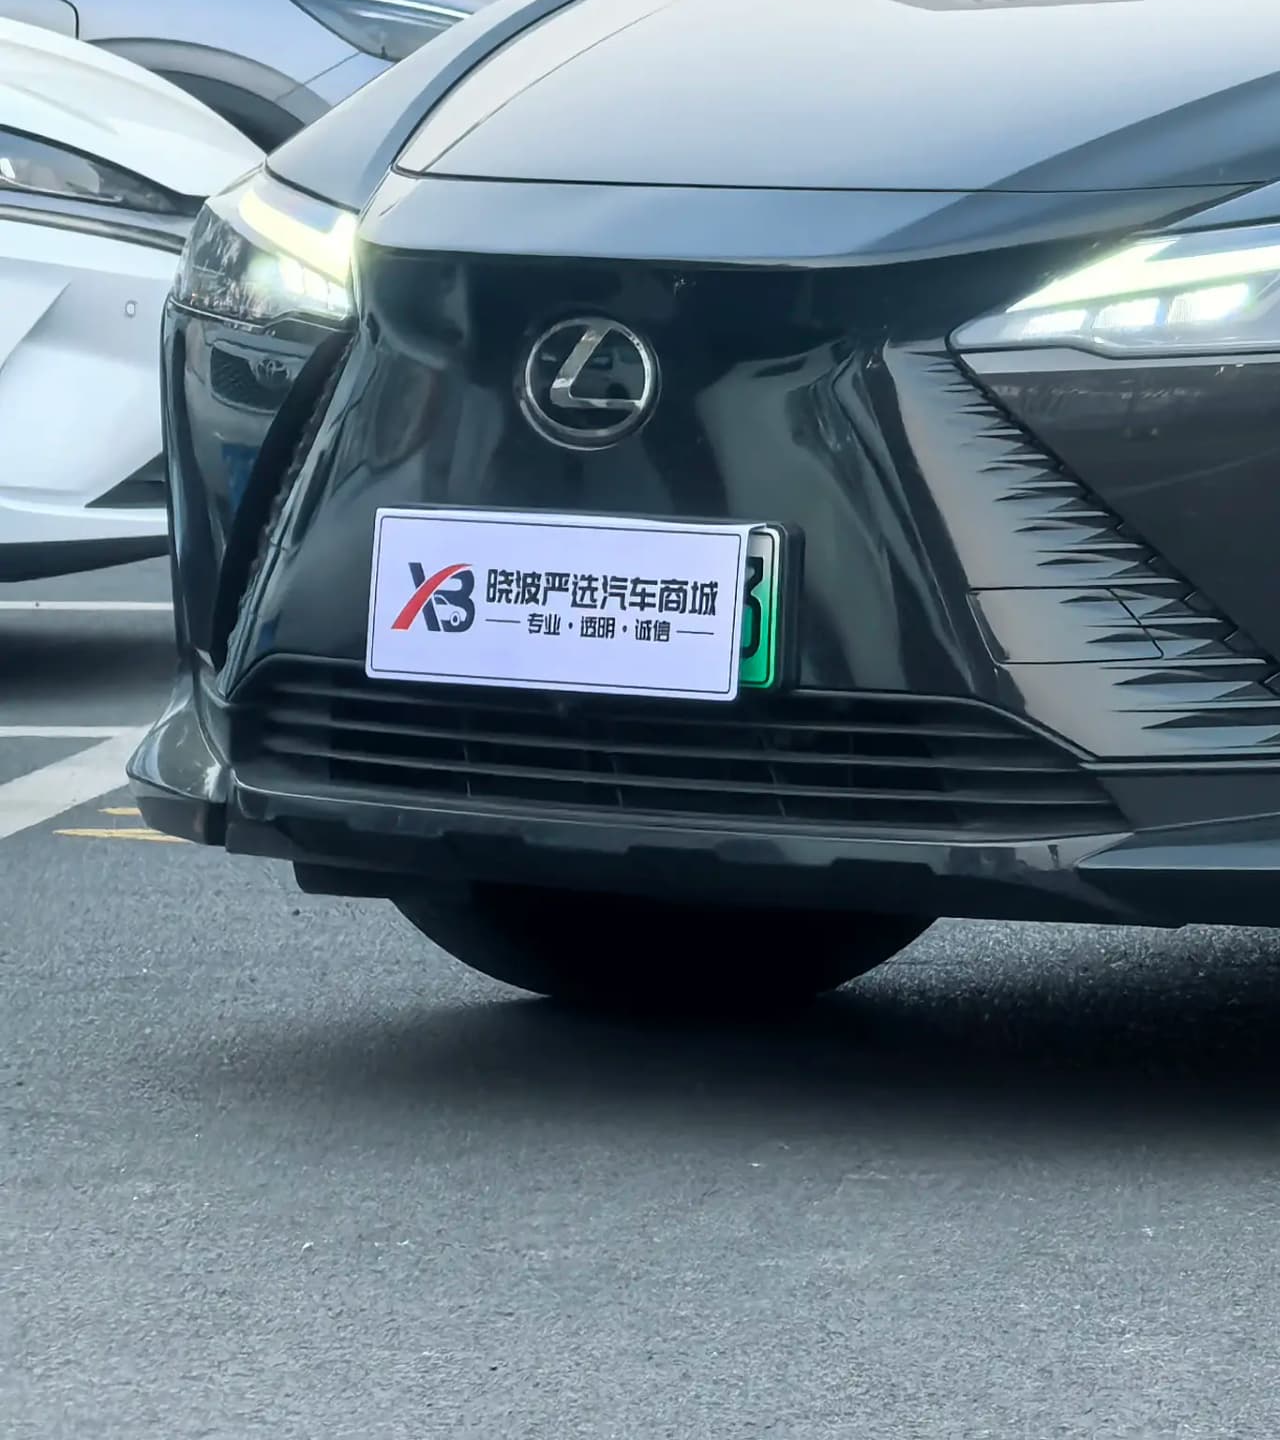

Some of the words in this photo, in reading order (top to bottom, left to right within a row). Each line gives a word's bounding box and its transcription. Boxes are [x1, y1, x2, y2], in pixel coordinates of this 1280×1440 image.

[486, 568, 718, 616] 晓波严选汽车商城
